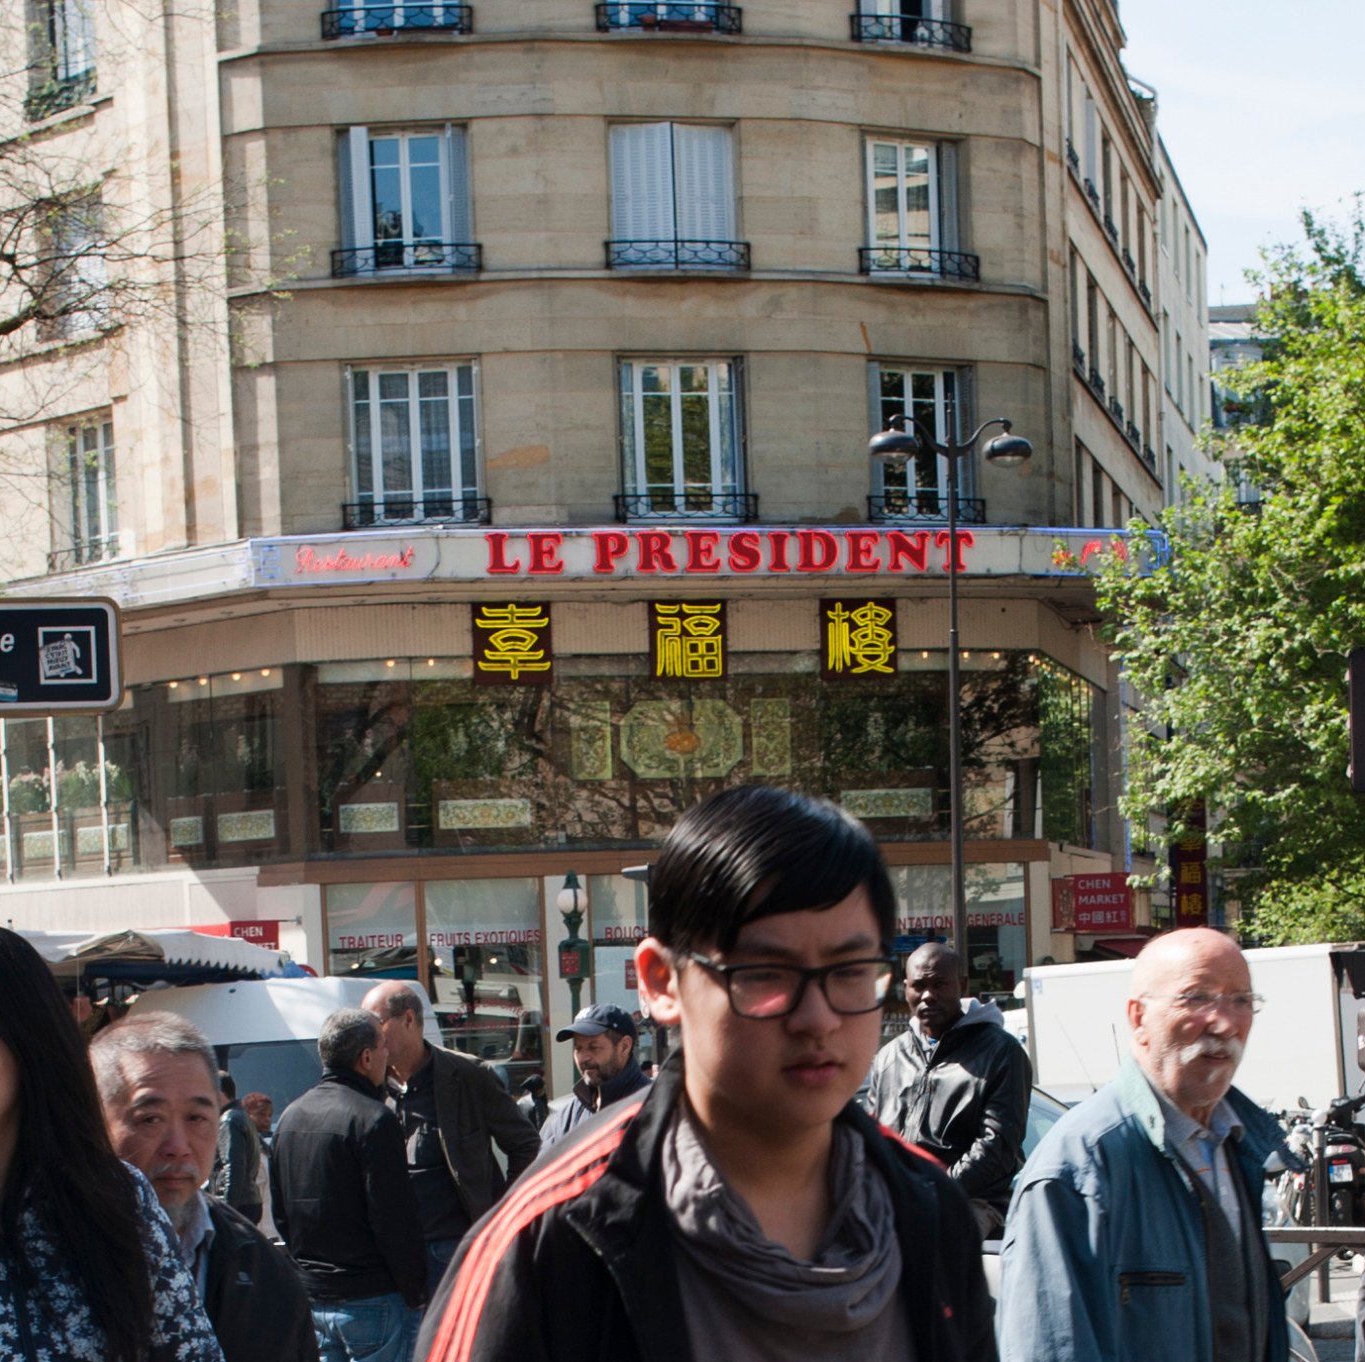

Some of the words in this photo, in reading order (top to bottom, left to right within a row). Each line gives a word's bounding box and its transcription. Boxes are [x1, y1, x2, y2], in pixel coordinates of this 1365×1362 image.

[295, 544, 415, 574] Restaurant
[485, 531, 564, 575] LE
[593, 530, 975, 574] PRESIDENT
[1077, 879, 1111, 890] CHEN
[1078, 893, 1126, 906] MARKET
[966, 912, 1025, 928] GENERALE
[234, 925, 263, 938] CHEN
[429, 931, 471, 947] FRUITS
[475, 928, 541, 946] EXOTIQUES
[339, 932, 404, 949] TRAITEUR
